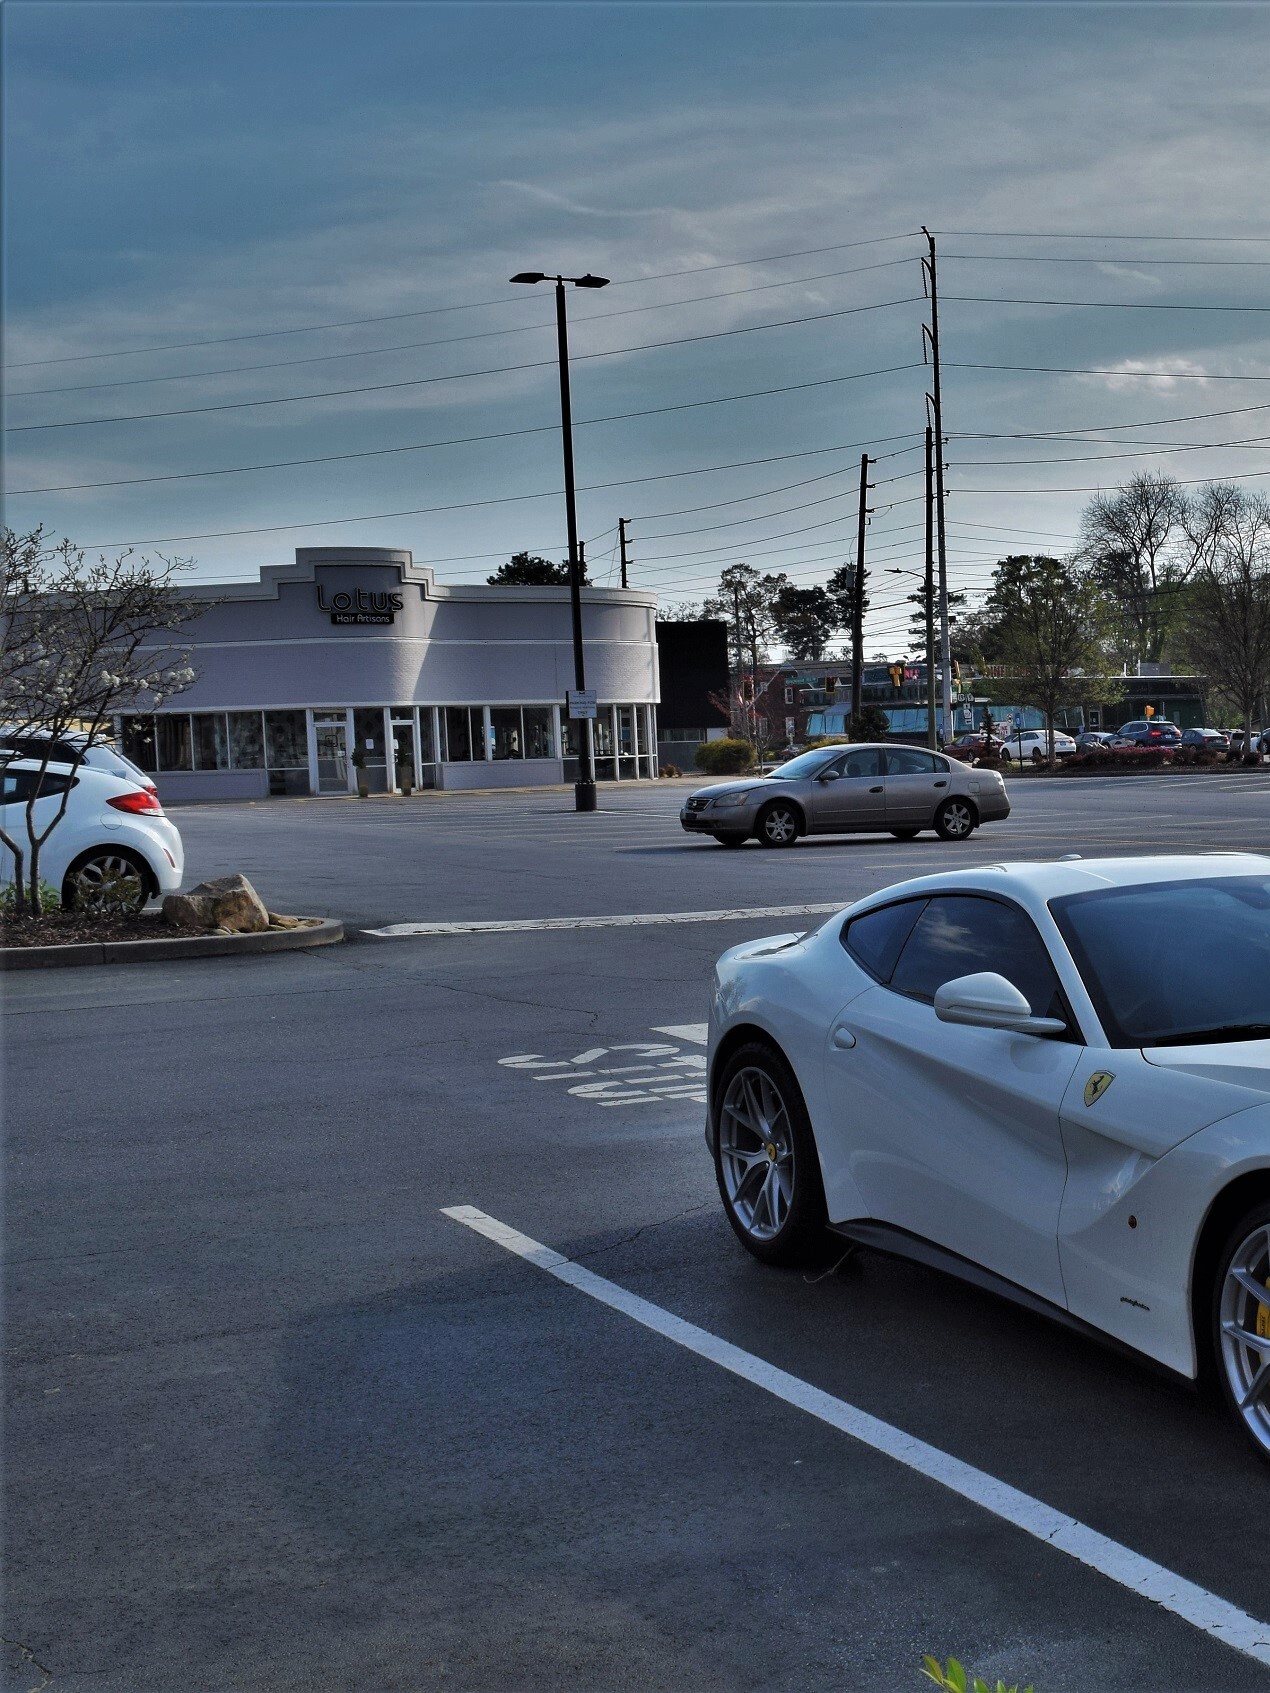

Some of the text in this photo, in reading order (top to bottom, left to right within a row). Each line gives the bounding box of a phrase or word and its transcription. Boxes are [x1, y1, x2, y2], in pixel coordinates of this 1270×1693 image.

[316, 584, 404, 612] Lotus
[336, 614, 390, 623] Hair Artisans
